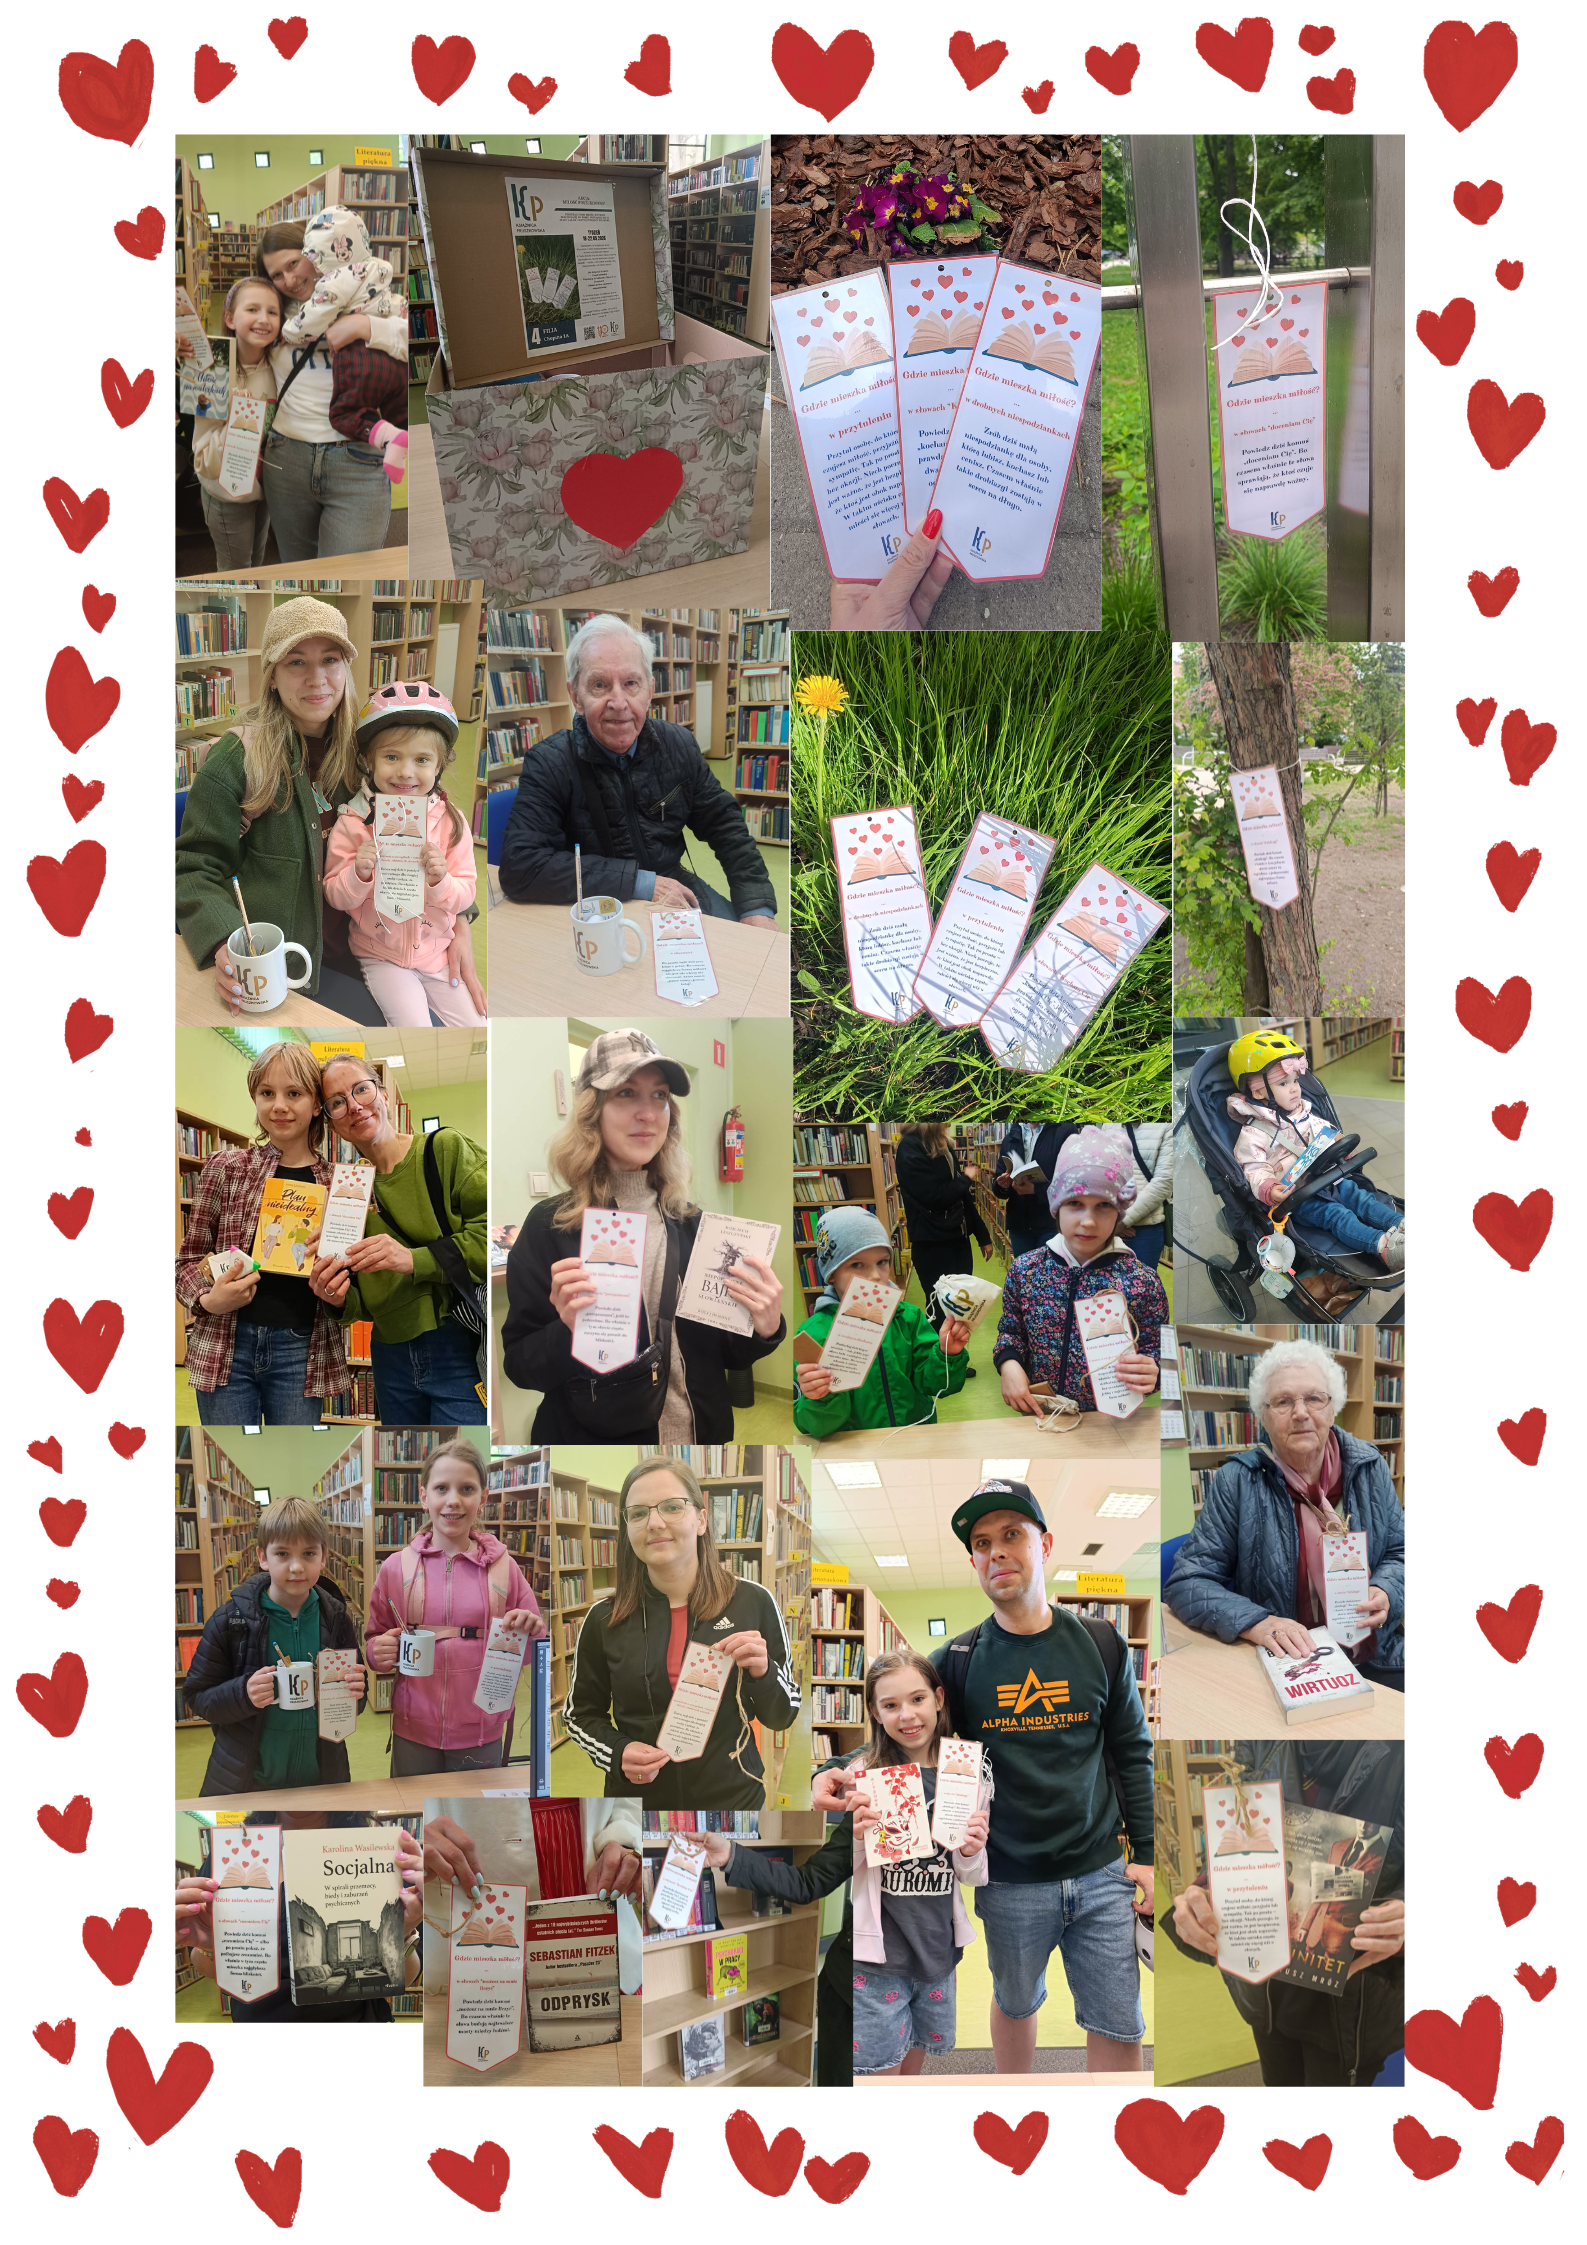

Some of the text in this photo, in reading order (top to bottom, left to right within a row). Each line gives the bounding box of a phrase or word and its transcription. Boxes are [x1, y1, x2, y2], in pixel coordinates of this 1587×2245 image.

[357, 148, 391, 156] Literatura
[532, 328, 541, 344] 4
[902, 366, 964, 379] Gdzie mieszka
[800, 374, 897, 413] Gdzie mieszka miłość
[974, 366, 1076, 408] Gdzie mieszka miłość?
[1226, 385, 1319, 407] Gdzie mieszka miłość?
[915, 404, 944, 412] słowach
[838, 412, 891, 438] przytuleniu
[971, 398, 1070, 440] drobnych niespodziankach
[918, 428, 949, 437] Powiedz
[1240, 426, 1265, 435] słowach
[964, 432, 1014, 457] niespodziankę
[1015, 452, 1026, 462] dla
[983, 426, 1037, 454] Zrób dziś małą
[1242, 445, 1270, 455] Powiedz
[1286, 438, 1308, 446] komuś
[826, 446, 851, 460] Przytul
[822, 460, 846, 473] czujesz
[861, 459, 873, 468] Tak
[863, 466, 882, 476] Niech
[961, 442, 979, 456] którą
[1005, 460, 1035, 478] kochasz
[1036, 473, 1049, 483] lub
[1236, 467, 1260, 475] czasem
[1262, 461, 1286, 470] właśnie
[956, 464, 1034, 505] takie drobiazgi zostają
[986, 464, 1013, 481] Czasem
[1015, 478, 1043, 493] właśnie
[1254, 480, 1285, 491] naprawdę
[871, 486, 887, 496] obok
[968, 482, 986, 494] sercu
[998, 495, 1022, 511] długo.
[852, 504, 871, 516] takim
[185, 718, 190, 726] T
[867, 888, 893, 896] mieszka
[956, 886, 1025, 916] Gdzie mieszka miłość?
[967, 915, 1004, 933] przytuleniu
[1046, 932, 1063, 946] Gdzie
[1063, 945, 1087, 964] mieszka
[1086, 961, 1110, 980] miłość?
[282, 1189, 306, 1201] Plan
[267, 1200, 318, 1218] nieidealny
[702, 1279, 730, 1298] BAJ
[1285, 1673, 1360, 1698] WIRTUOZ
[982, 1712, 1089, 1728] ALPHA INDUSTRIES
[322, 1843, 395, 1853] Karolina Wasilewska
[323, 1857, 395, 1879] Socjalna
[881, 1869, 952, 1892] KUROMI
[1232, 1884, 1267, 1892] przytuleniu
[325, 1900, 360, 1908] psychicznych
[529, 1945, 615, 1962] SEBASTIAN FITZEK
[1292, 1948, 1345, 1974] NITET
[1312, 1974, 1339, 1988] MRÓZ
[541, 1991, 611, 2012] ODPRYSK
